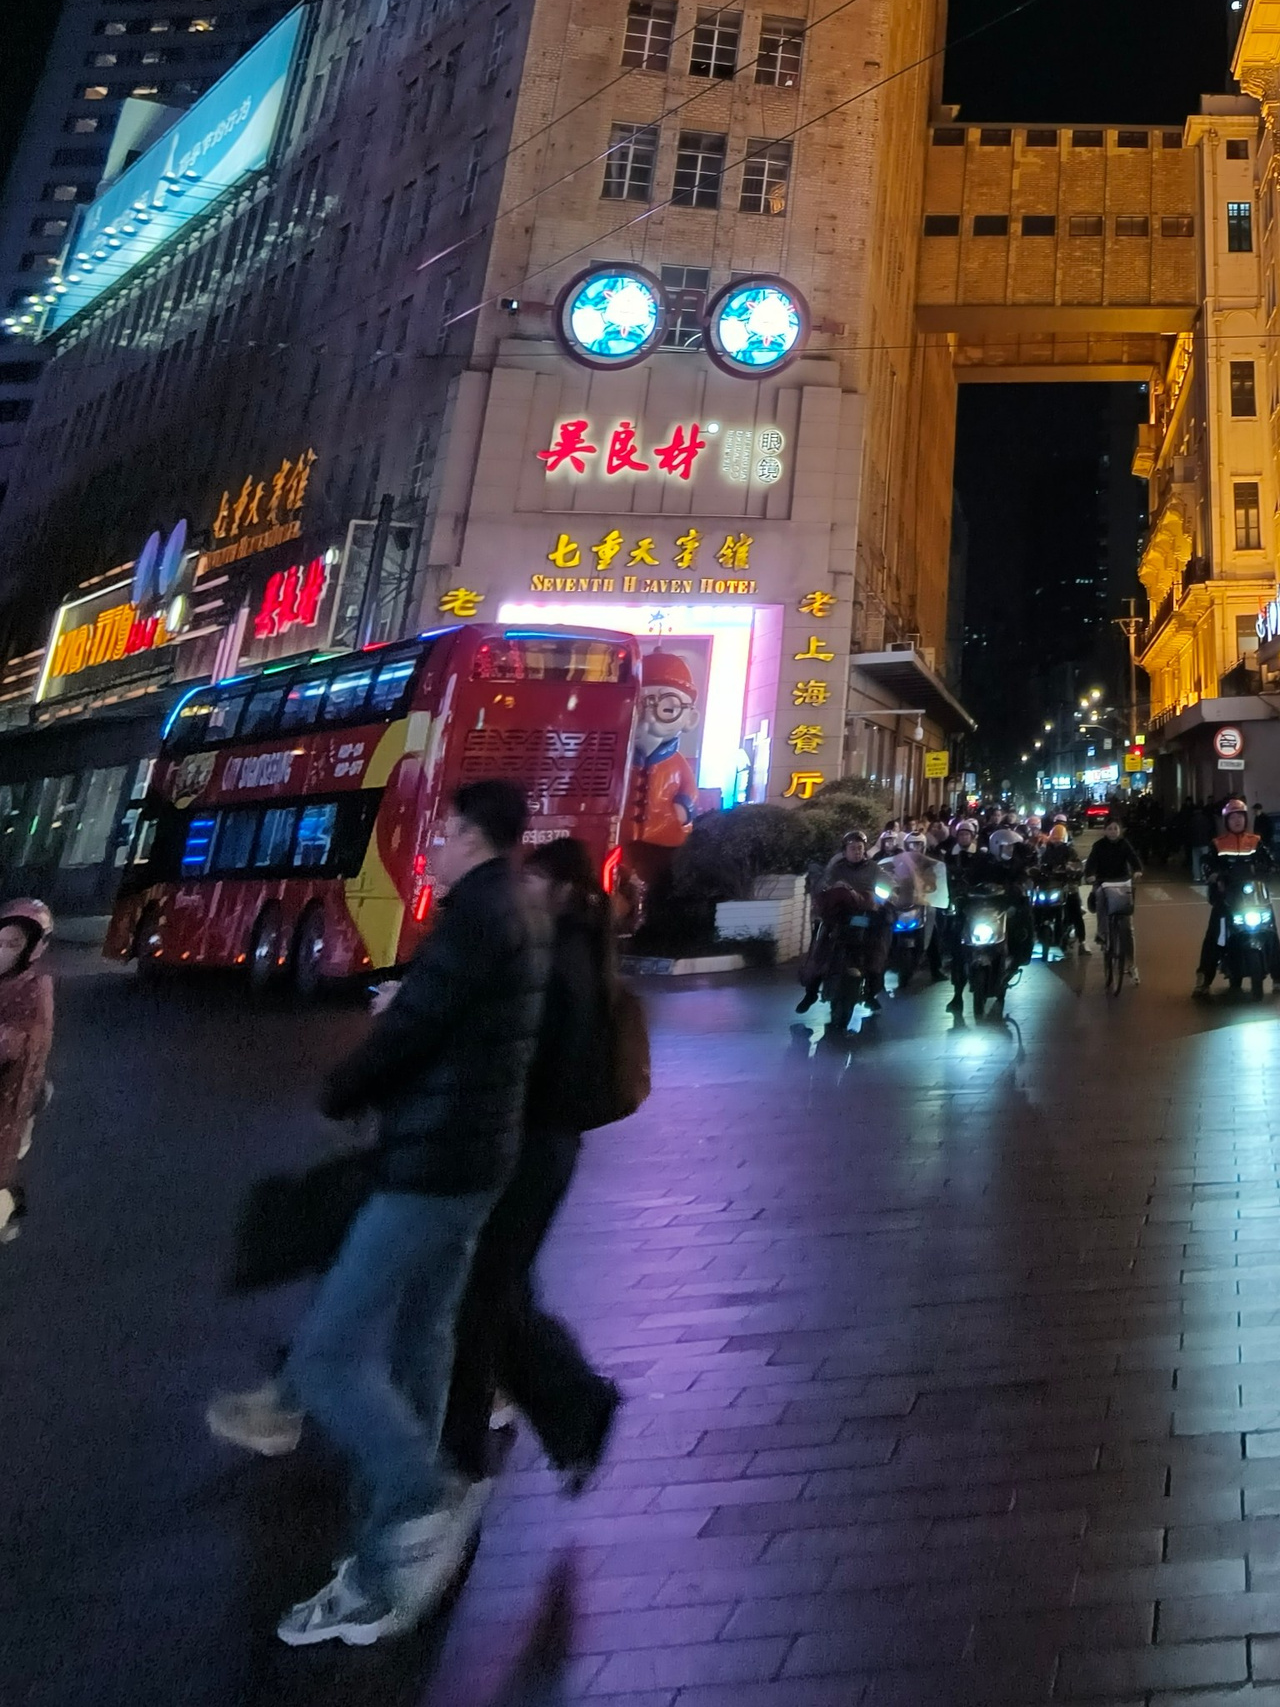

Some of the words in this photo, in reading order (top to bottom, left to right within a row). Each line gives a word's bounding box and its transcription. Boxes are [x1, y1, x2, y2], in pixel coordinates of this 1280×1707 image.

[530, 575, 615, 593] SEVENTH
[700, 578, 759, 594] HOTEL
[783, 590, 838, 800] 老上海餐厅
